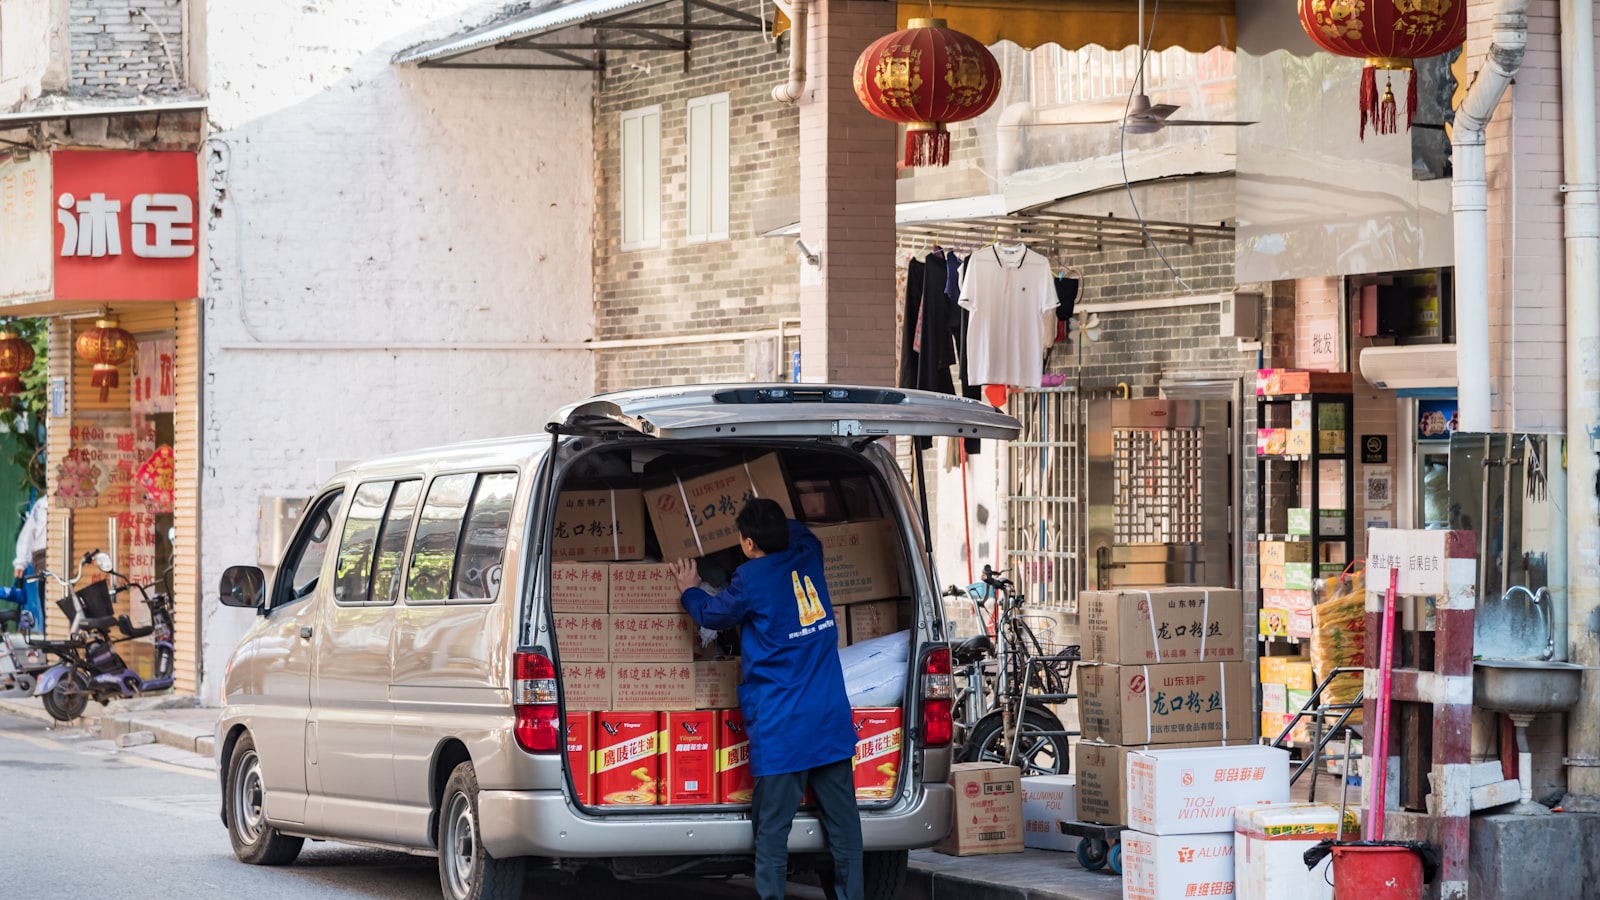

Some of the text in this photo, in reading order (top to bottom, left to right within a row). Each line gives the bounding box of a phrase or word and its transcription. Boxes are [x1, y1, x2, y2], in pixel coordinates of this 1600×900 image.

[58, 192, 195, 258] 沐足
[1312, 332, 1332, 355] 批发
[692, 476, 735, 497] 山东特产
[566, 498, 606, 508] 山东特产
[554, 520, 623, 539] 龙口粉丝
[1409, 555, 1438, 571] 后果自负
[1168, 599, 1205, 608] 山东特产
[1157, 620, 1222, 639] 龙口粉丝
[1146, 649, 1186, 659] 粉认品牌
[1163, 676, 1205, 687] 山东特产
[1152, 690, 1223, 715] 龙口粉丝
[1029, 792, 1064, 800] ALUMINUM
[1184, 797, 1215, 808] FOIL
[1046, 801, 1061, 810] FOIL
